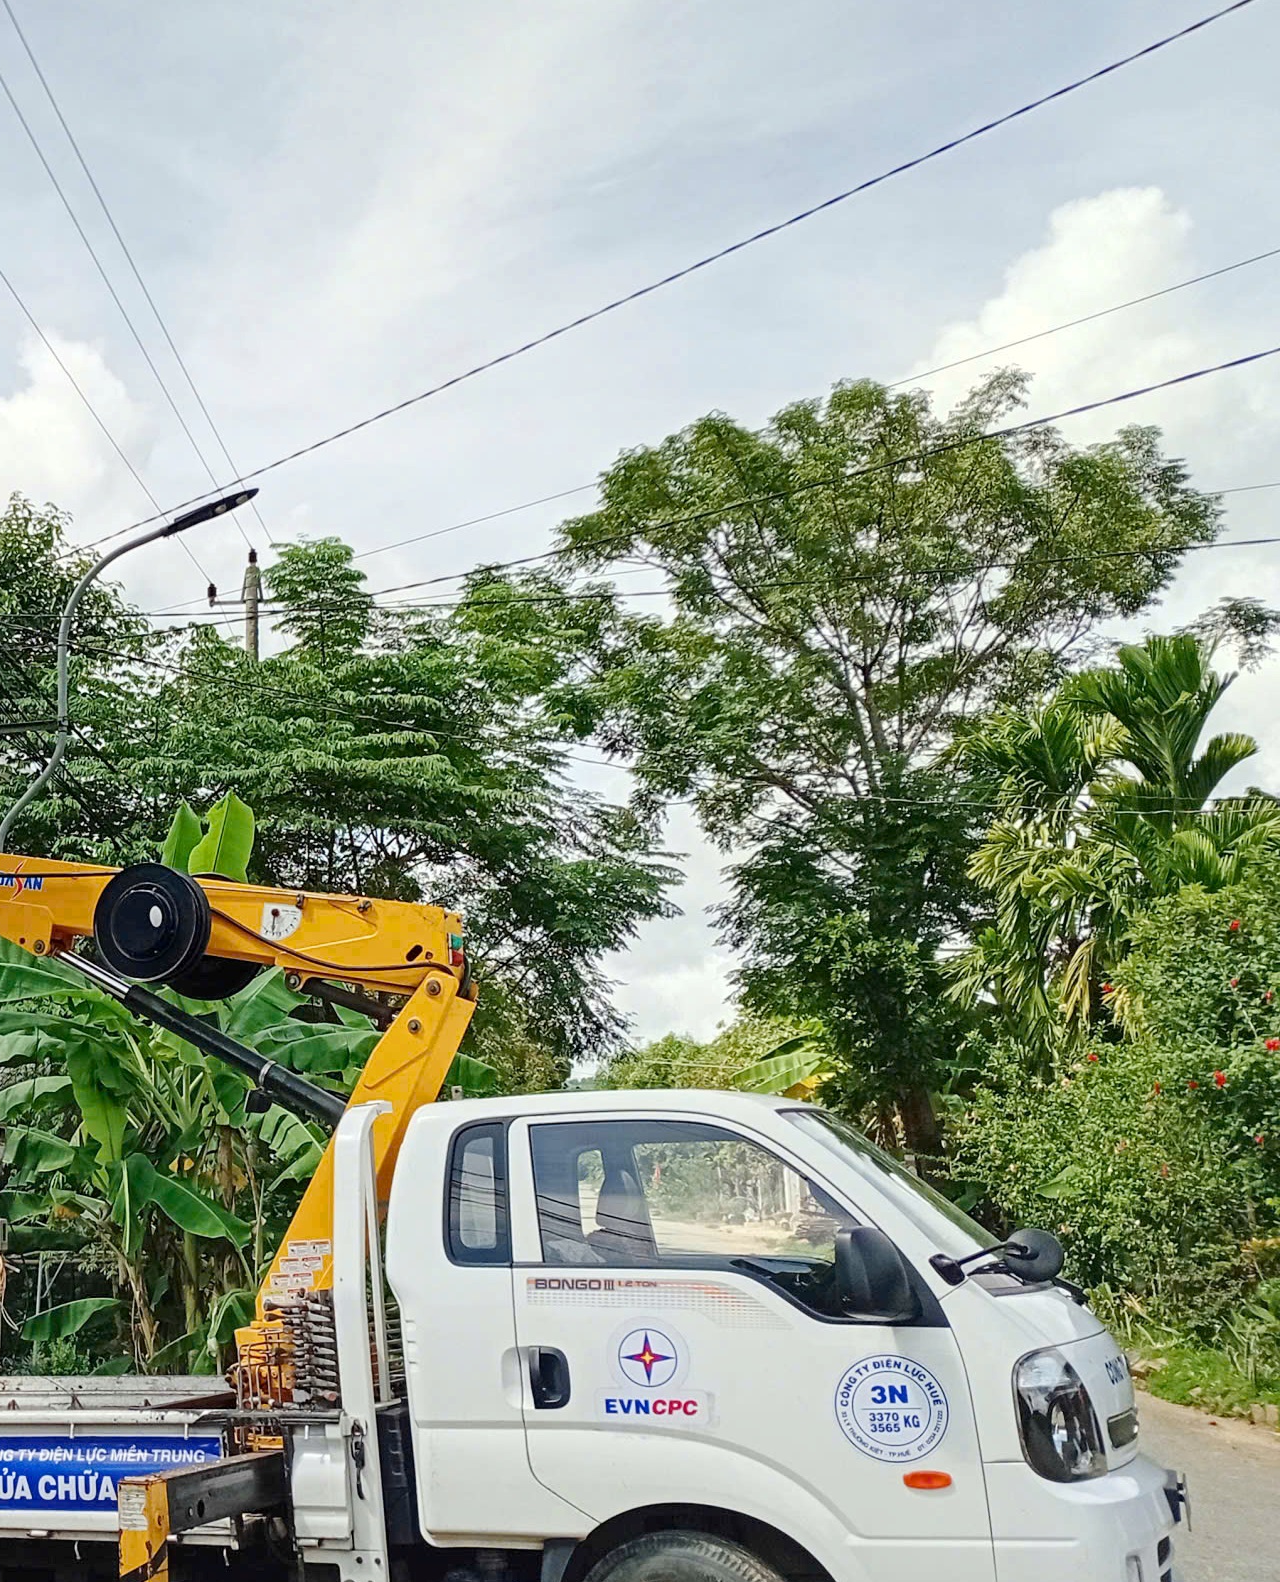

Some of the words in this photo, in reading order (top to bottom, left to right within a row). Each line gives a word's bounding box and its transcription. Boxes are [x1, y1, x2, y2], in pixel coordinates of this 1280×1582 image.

[535, 1279, 601, 1290] BONGO
[635, 1280, 657, 1288] TON
[840, 1376, 858, 1407] CÔNG
[855, 1364, 869, 1376] TY
[924, 1381, 944, 1406] HUẾ
[871, 1385, 909, 1404] 3N
[605, 1398, 698, 1416] EVNCPC
[869, 1412, 899, 1422] 3370
[903, 1415, 920, 1428] KG
[870, 1423, 901, 1433] 3565
[19, 1449, 37, 1462] TY
[39, 1447, 71, 1464] ĐIỆN
[77, 1446, 107, 1465] LỰC
[110, 1446, 149, 1463] MIỀN
[152, 1449, 205, 1463] TRUNG
[37, 1469, 119, 1501] CHỮA
